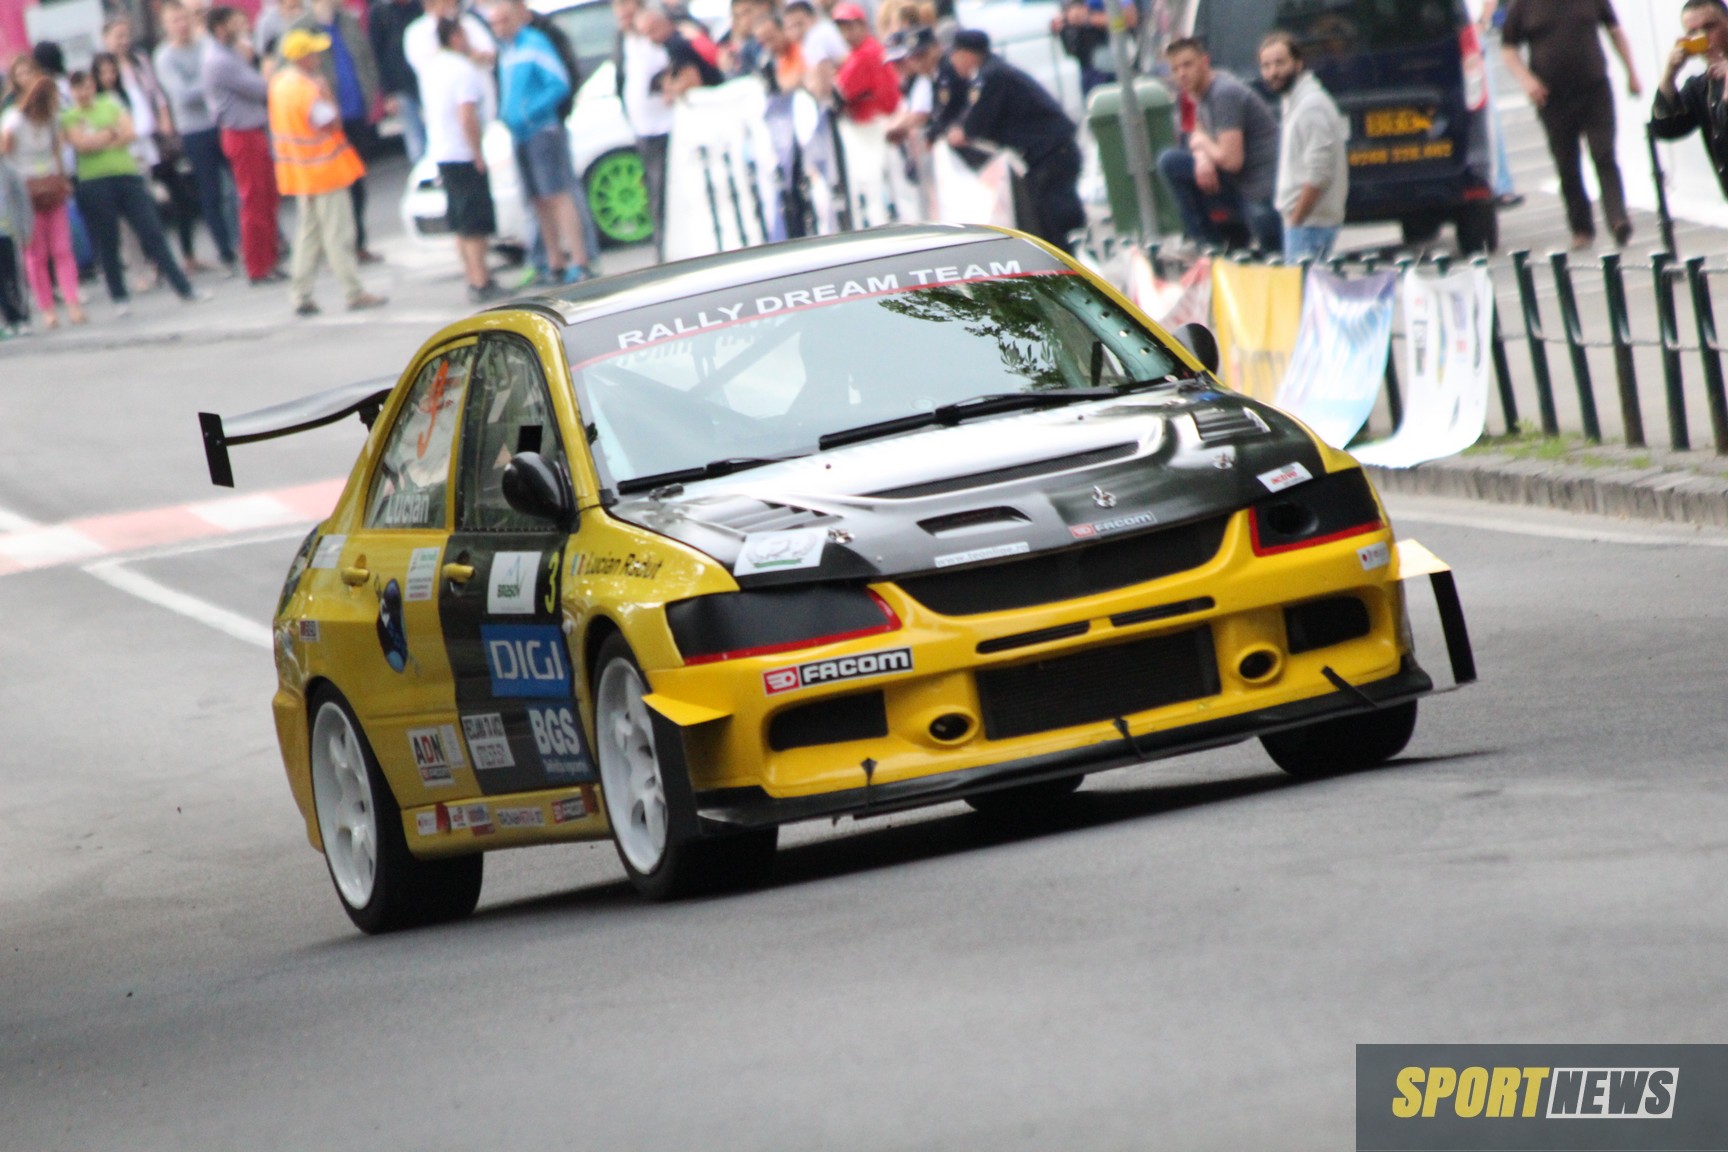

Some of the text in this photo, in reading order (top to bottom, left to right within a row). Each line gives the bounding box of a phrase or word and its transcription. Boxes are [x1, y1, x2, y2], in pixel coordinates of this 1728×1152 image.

[617, 260, 1023, 349] RALLY DREAM TEAM
[545, 551, 560, 614] 3
[489, 640, 565, 681] DIGI
[803, 651, 909, 683] FACOM
[413, 733, 445, 766] ADN
[528, 707, 581, 756] BGS
